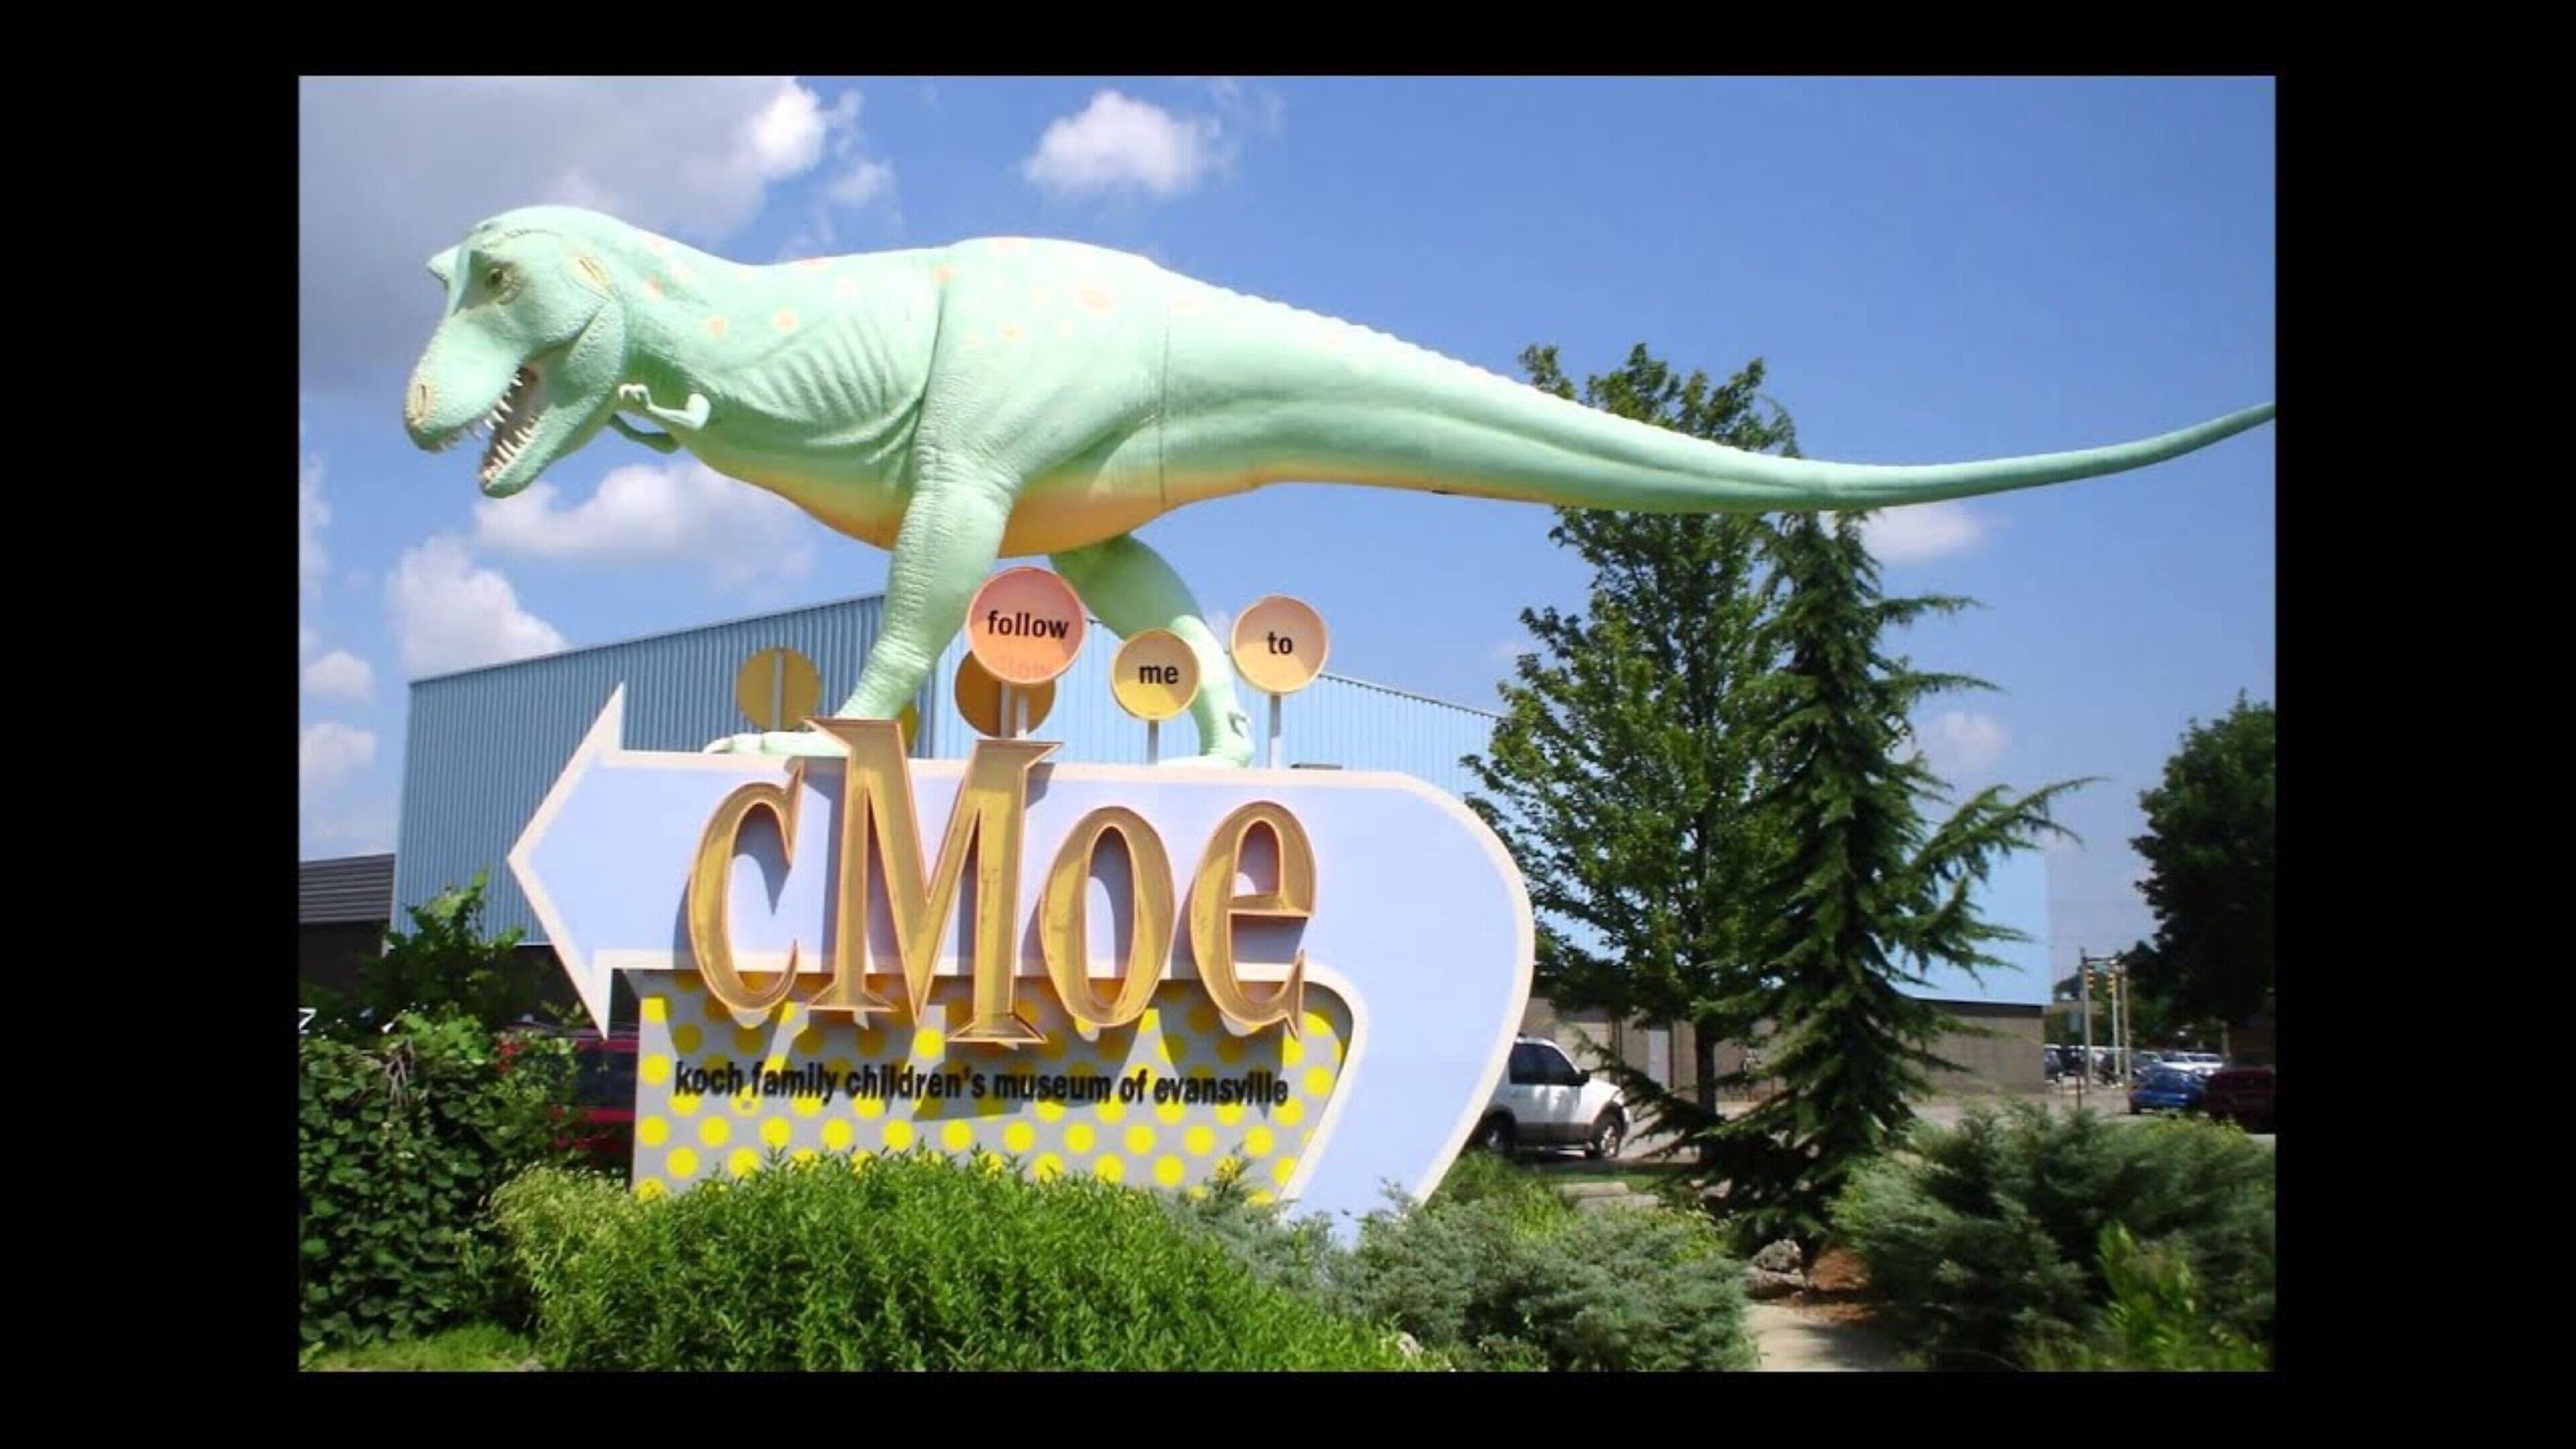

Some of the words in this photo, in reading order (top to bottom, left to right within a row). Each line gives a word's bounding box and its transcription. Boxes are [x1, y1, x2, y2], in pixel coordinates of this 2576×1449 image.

[987, 610, 1069, 639] follow
[1267, 631, 1293, 655] to
[1139, 663, 1179, 685] me
[687, 717, 1317, 1044] cMoe
[674, 1061, 743, 1096] koch
[751, 1061, 838, 1106] family
[845, 1064, 986, 1099] children's
[993, 1073, 1112, 1104] museum
[1118, 1069, 1148, 1104] of
[1153, 1071, 1289, 1106] evansville
